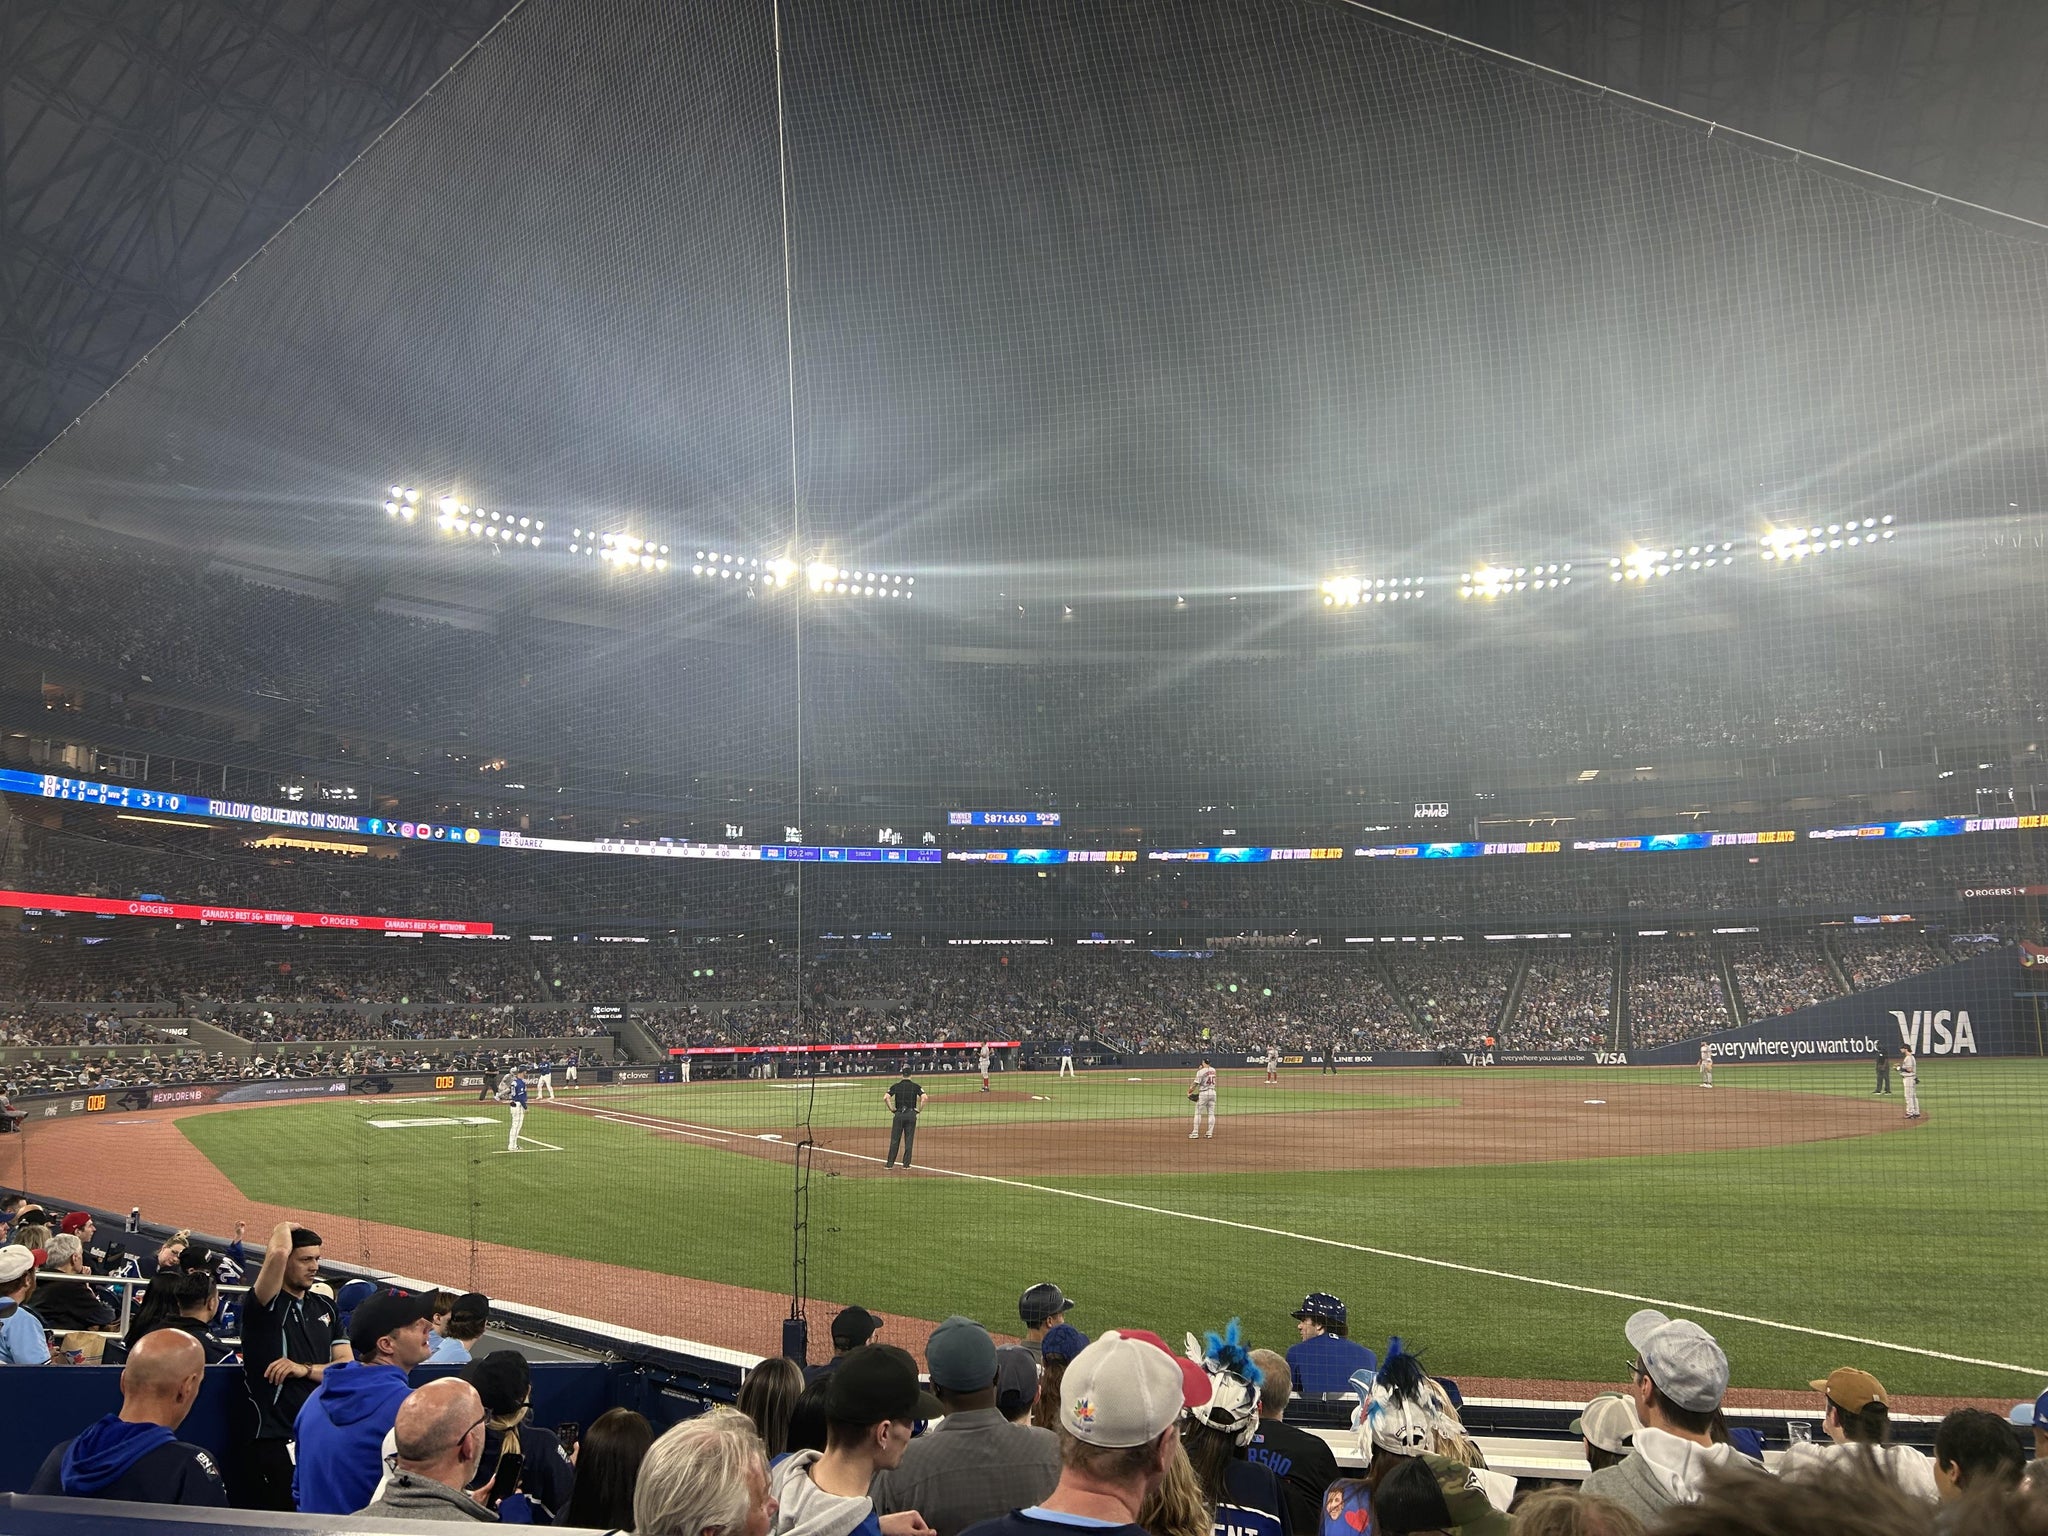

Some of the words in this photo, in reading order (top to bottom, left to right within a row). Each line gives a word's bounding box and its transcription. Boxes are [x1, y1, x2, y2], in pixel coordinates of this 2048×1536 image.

[141, 794, 150, 807] 3
[157, 795, 163, 808] 1
[170, 796, 178, 810] 0
[210, 801, 250, 818] FOLLOW
[252, 806, 308, 825] @BLUEJAYS
[311, 814, 324, 827] ON
[327, 814, 359, 831] SOCIAL
[1414, 809, 1448, 818] KPMG
[1966, 820, 1981, 832] BET
[1981, 819, 1994, 830] ON
[1994, 817, 2018, 829] YOUR
[2018, 816, 2040, 828] BLUE
[1712, 834, 1725, 845] BET
[1726, 834, 1737, 845] ON
[1737, 833, 1757, 844] YOUR
[1758, 832, 1776, 843] BLUE
[1776, 831, 1795, 842] JAYS
[1809, 829, 1858, 839] theScore
[514, 838, 543, 848] SUAREZ
[1484, 844, 1496, 854] BET
[1544, 841, 1560, 852] JAYS
[1574, 841, 1617, 850] theScore
[1068, 852, 1079, 861] BET
[1122, 851, 1137, 861] JAYS
[1327, 848, 1343, 858] JAYS
[140, 905, 174, 915] ROGERS
[202, 909, 234, 919] CANADA'S
[236, 912, 250, 920] BEST
[265, 914, 294, 922] NETWORK
[330, 917, 359, 926] ROGERS
[1889, 1010, 1977, 1054] VISA
[1710, 1038, 1788, 1059] everywhere
[1790, 1042, 1814, 1058] you
[1817, 1040, 1848, 1054] want
[1850, 1038, 1864, 1053] to
[1462, 1052, 1495, 1064] VA
[1592, 1052, 1627, 1064] VISA
[153, 1091, 202, 1102] #EXPLORENB
[1248, 1448, 1292, 1476] RSHO
[1210, 1523, 1258, 1536] ENT
